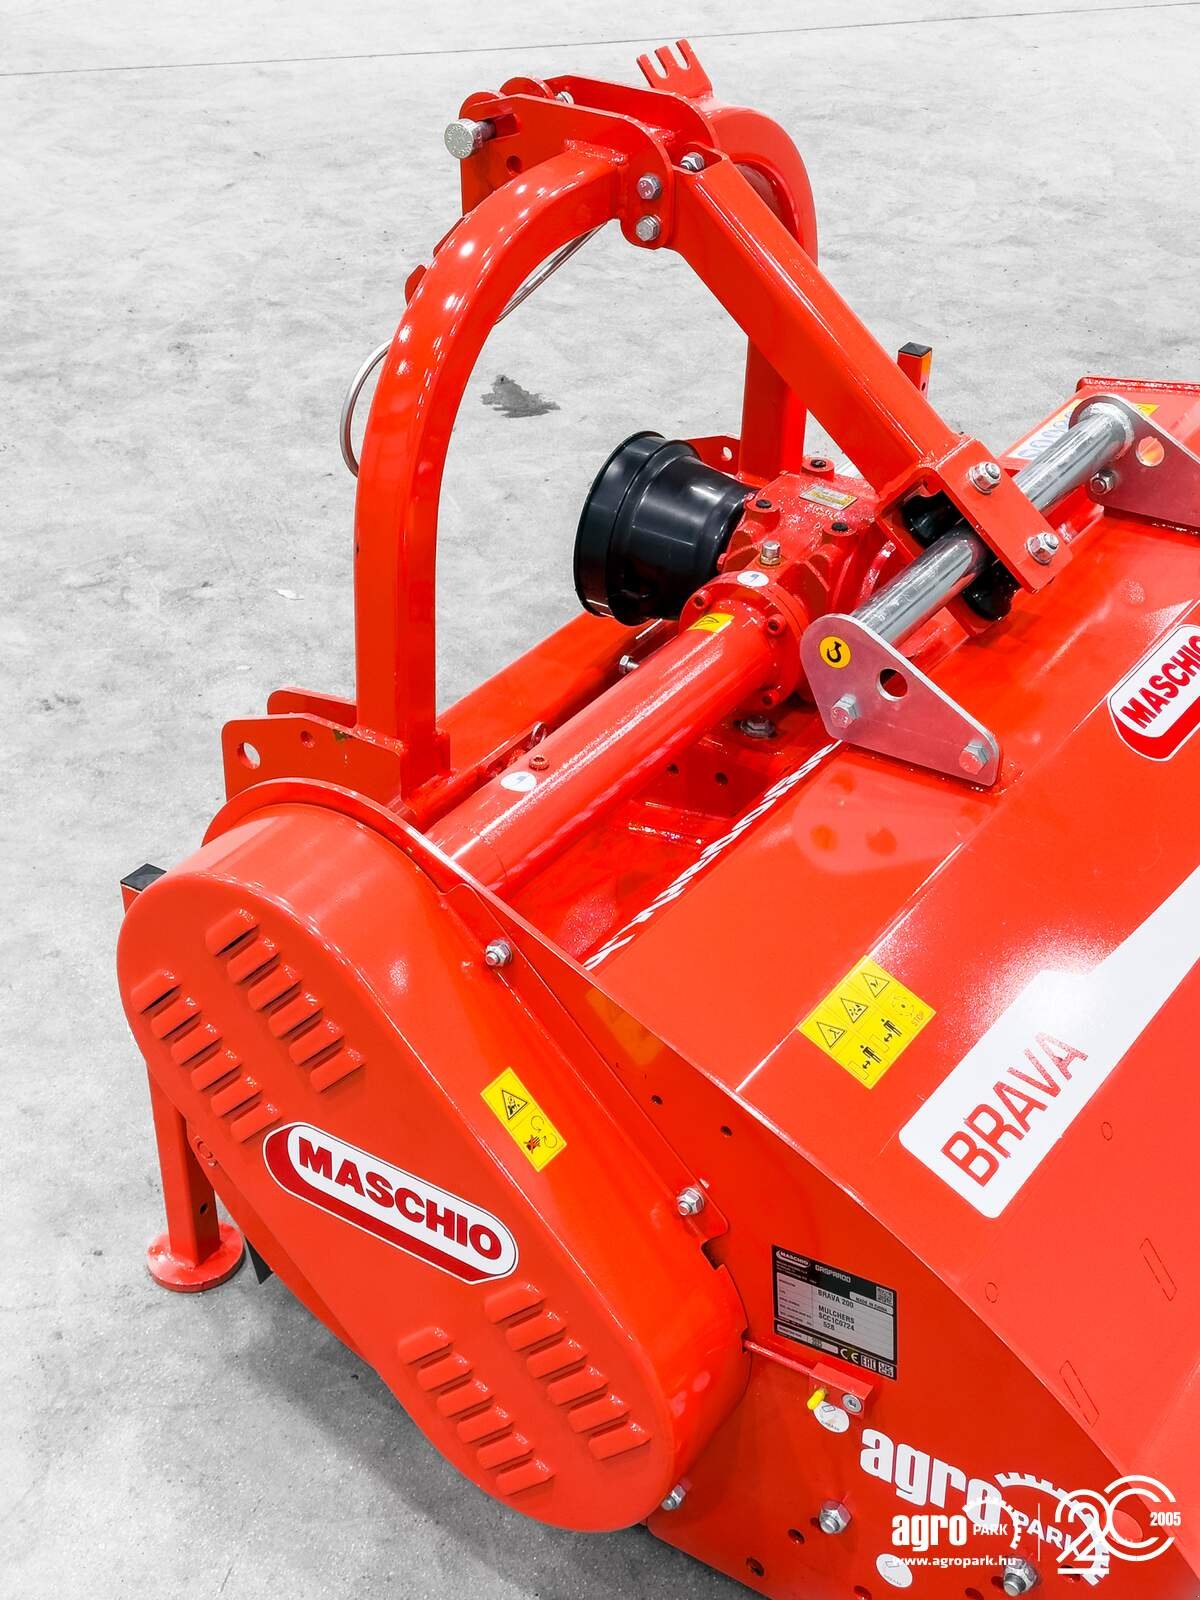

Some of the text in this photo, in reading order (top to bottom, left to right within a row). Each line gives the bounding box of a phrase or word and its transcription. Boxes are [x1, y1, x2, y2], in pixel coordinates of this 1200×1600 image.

[940, 1032, 1088, 1187] BRAVA
[298, 1136, 502, 1260] MASCHIO
[815, 1264, 851, 1283] GASPARDO
[818, 1289, 854, 1309] BRAVA 200
[818, 1305, 855, 1325] MULCHERS
[823, 1321, 836, 1332] 528
[860, 1428, 1002, 1527] agro
